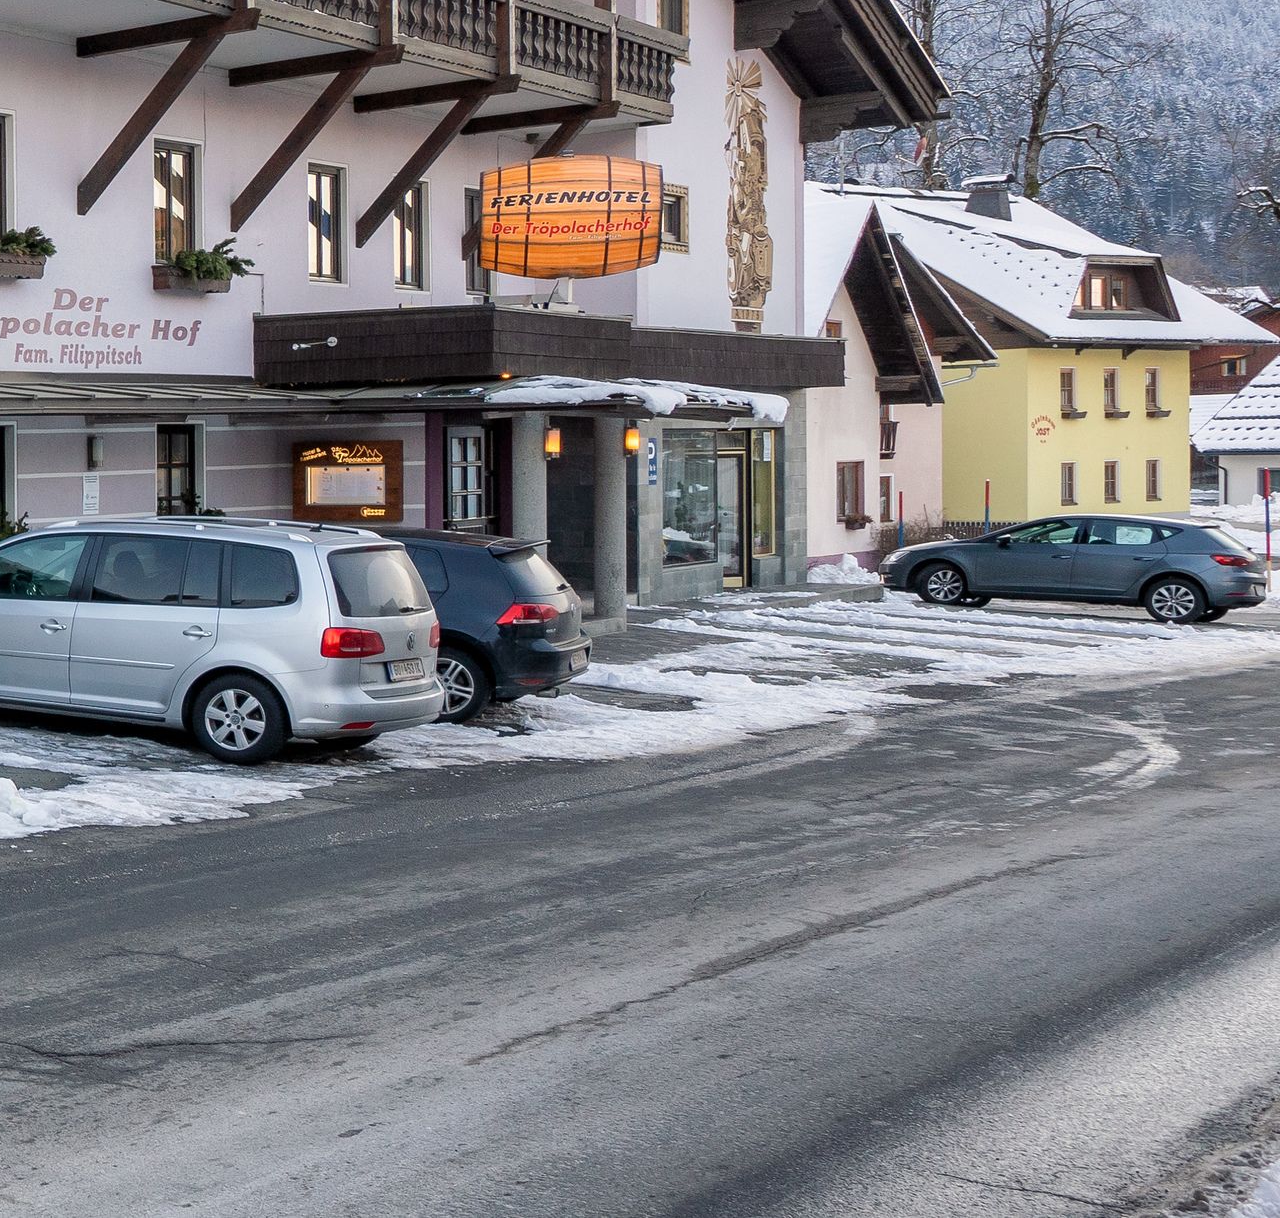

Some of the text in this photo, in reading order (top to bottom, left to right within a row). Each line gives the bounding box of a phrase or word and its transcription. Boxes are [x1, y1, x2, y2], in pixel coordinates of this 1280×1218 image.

[490, 190, 652, 209] FERIENHOTEL
[492, 215, 652, 238] Der Tröpolacherhof
[53, 288, 109, 312] Der
[151, 319, 202, 346] Hof
[14, 343, 143, 369] Fam. Filippitsch
